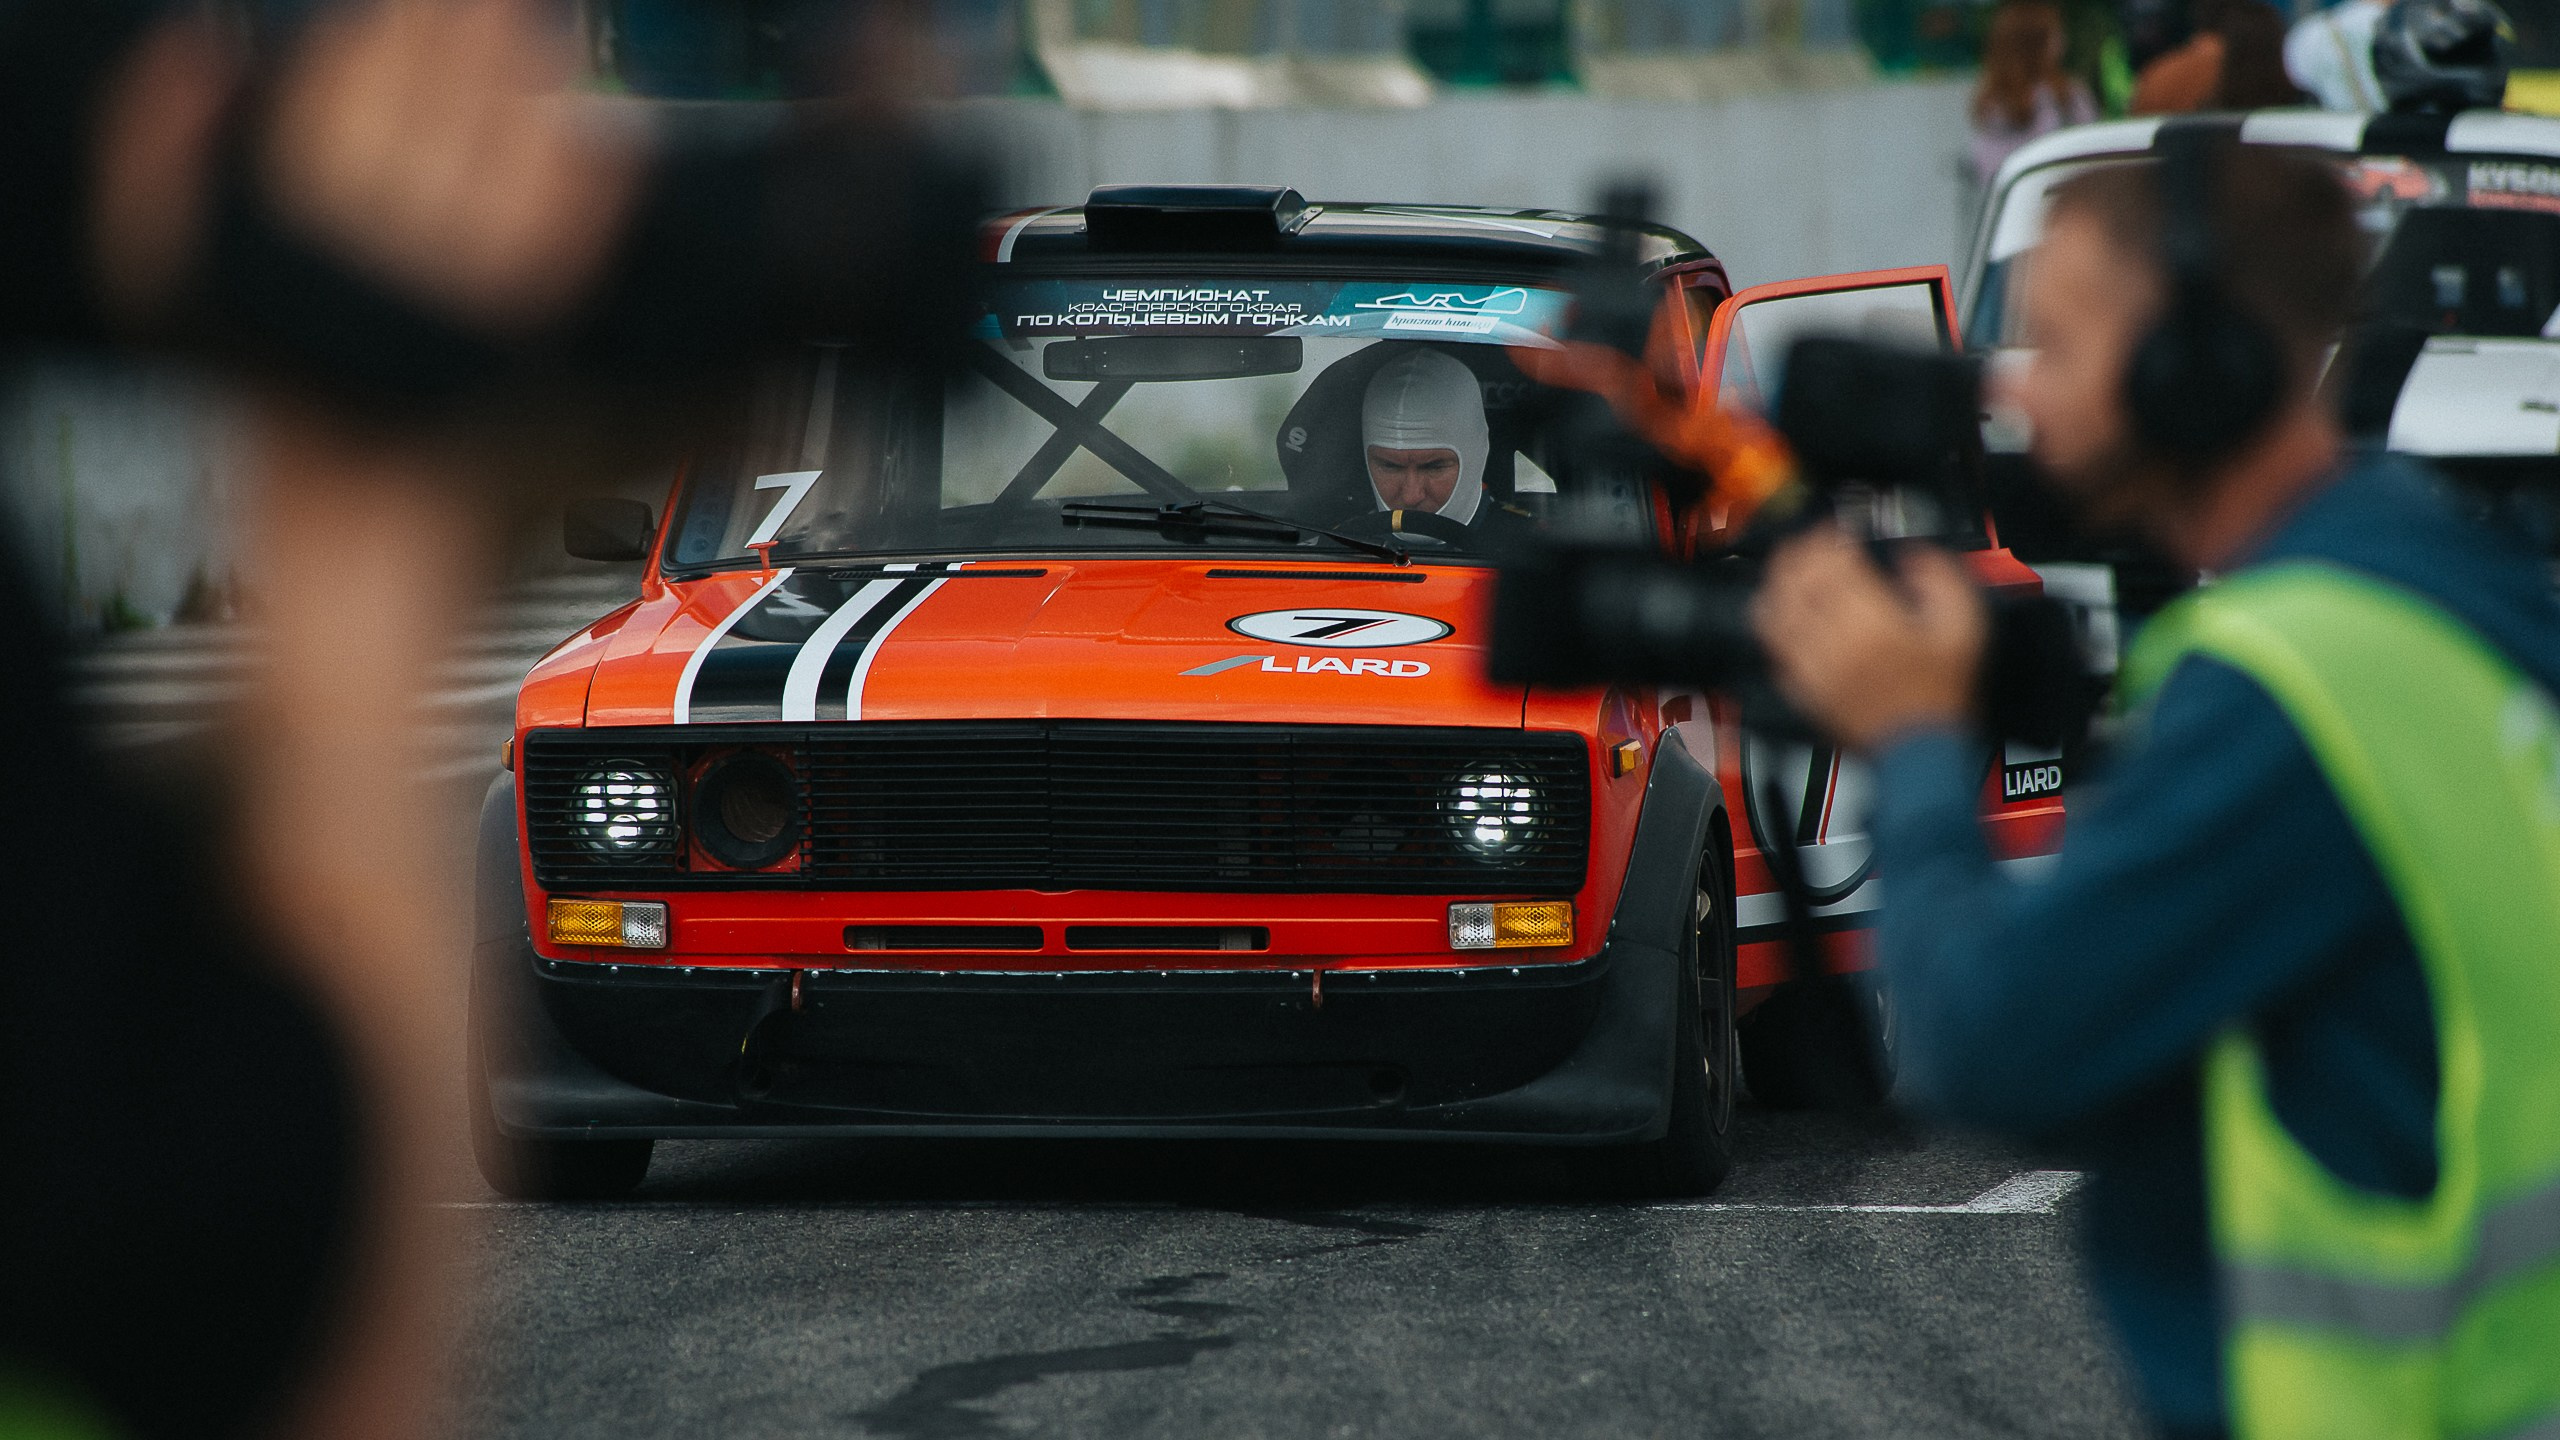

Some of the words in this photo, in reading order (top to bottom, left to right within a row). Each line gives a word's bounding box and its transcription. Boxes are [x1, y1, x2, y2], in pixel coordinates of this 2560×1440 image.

[1102, 289, 1270, 302] ЧЕМПИОНАТ
[1068, 302, 1244, 313] КРАСНОЯРСКОГО
[1246, 302, 1302, 313] КРАЯ
[1016, 314, 1053, 326] ПО
[1056, 313, 1229, 326] КОЛЬЦЕВЫМ
[1235, 313, 1351, 327] ГОНКАМ
[744, 470, 823, 548] 7
[1290, 615, 1396, 639] 7
[1260, 655, 1432, 678] LIARD
[2005, 765, 2062, 796] LIARD
